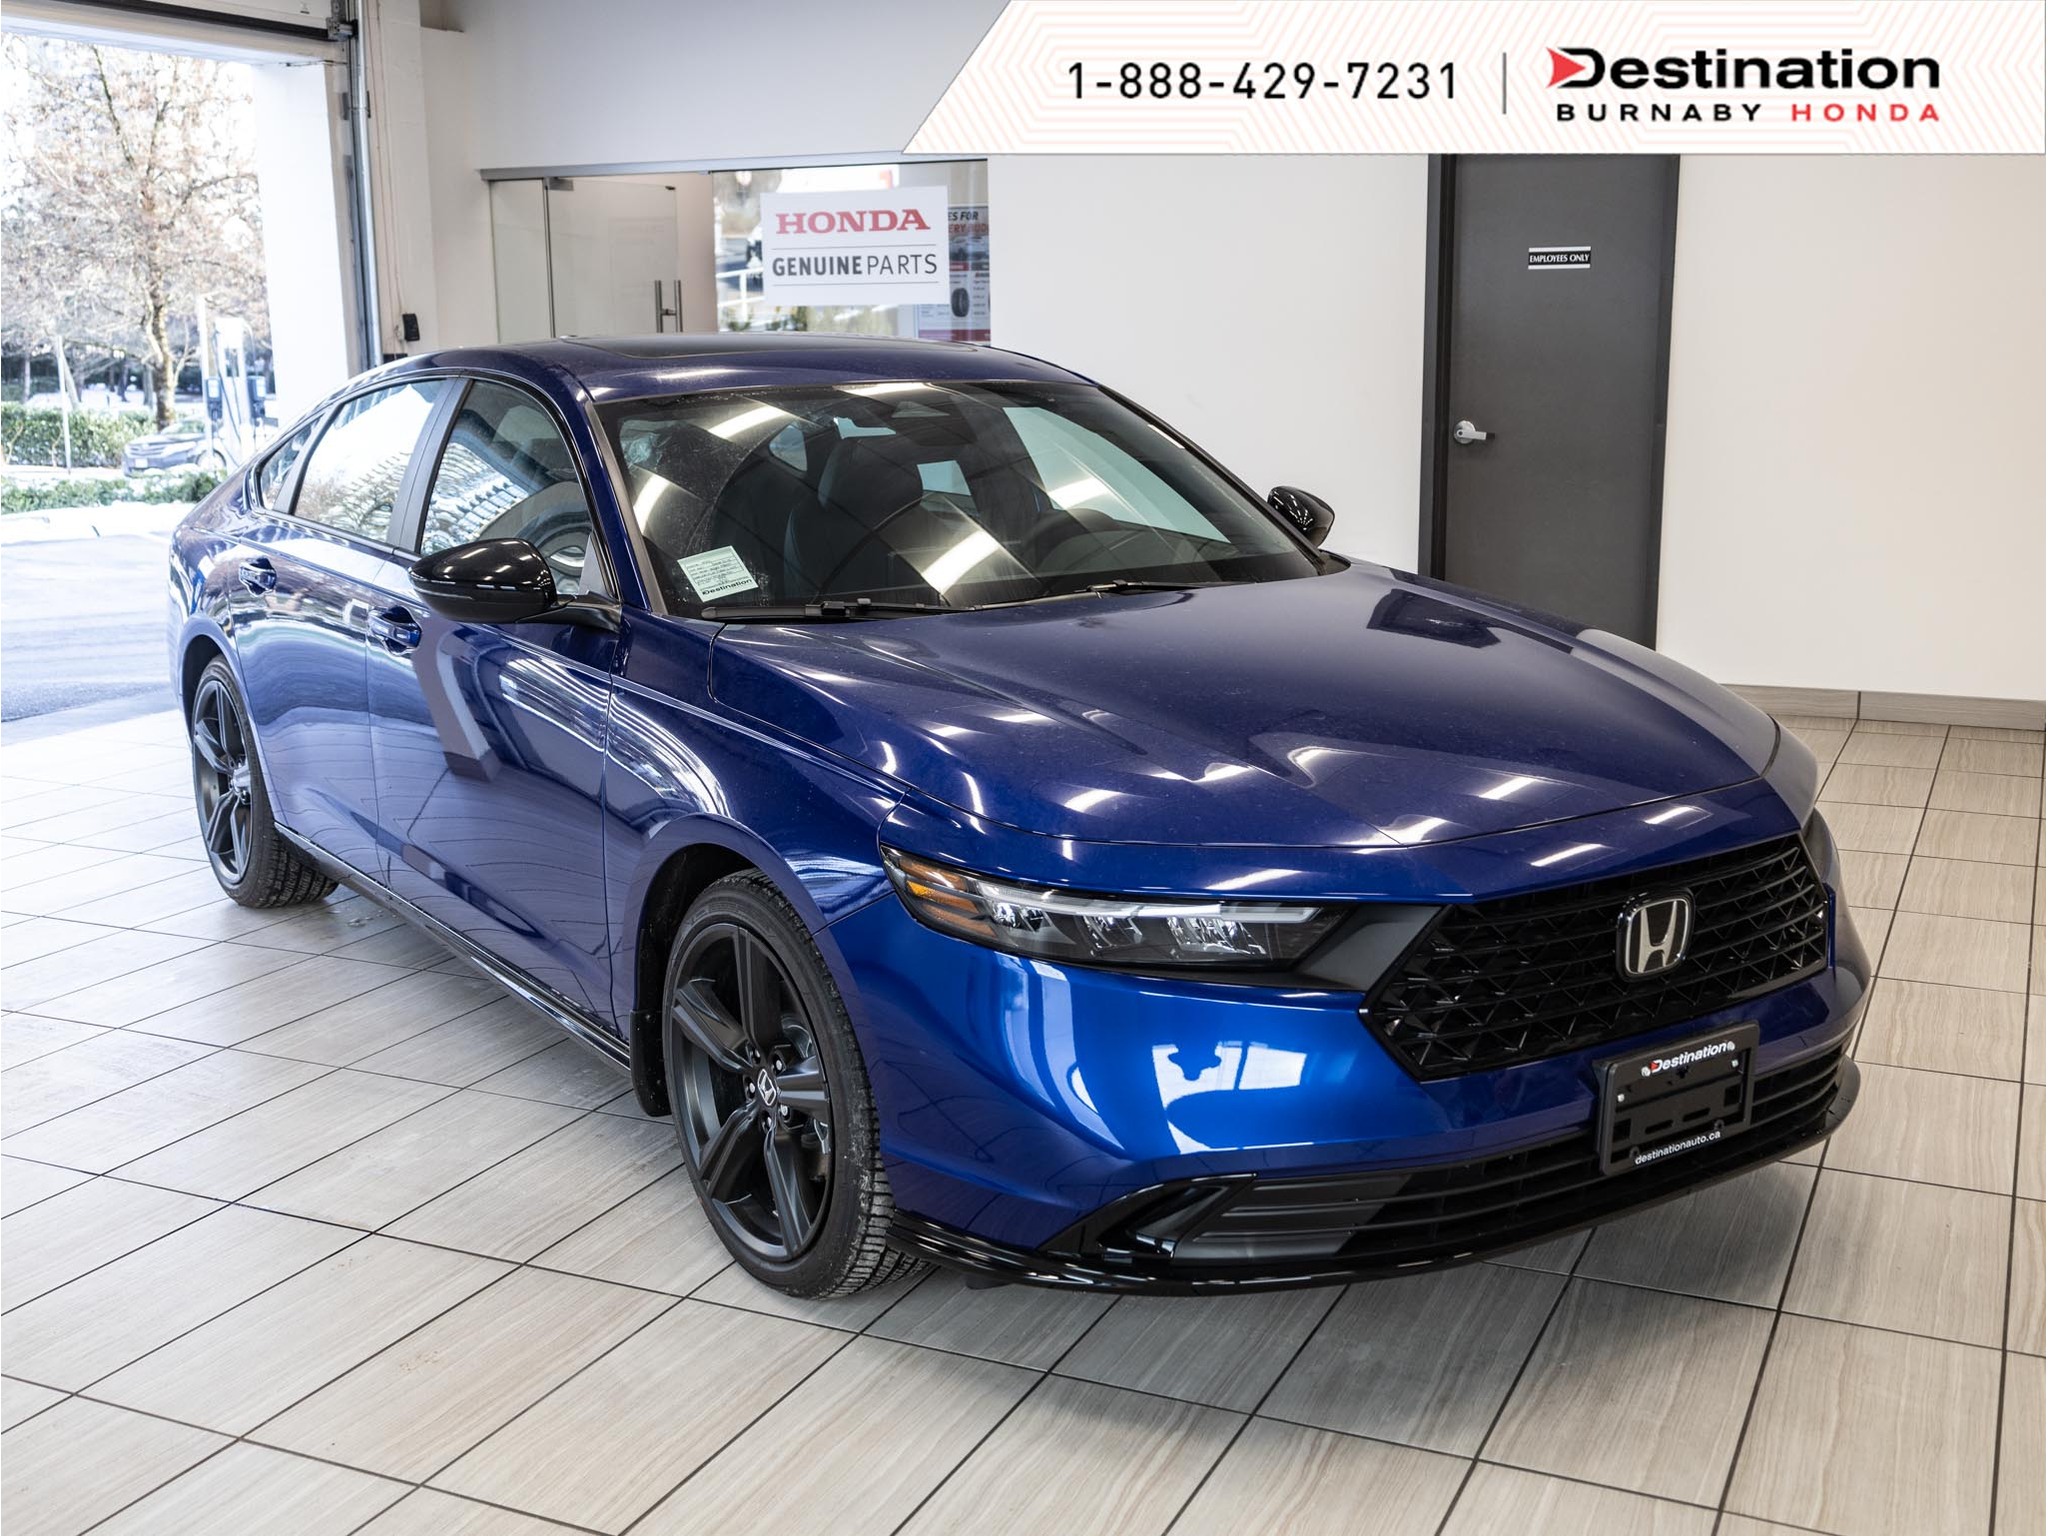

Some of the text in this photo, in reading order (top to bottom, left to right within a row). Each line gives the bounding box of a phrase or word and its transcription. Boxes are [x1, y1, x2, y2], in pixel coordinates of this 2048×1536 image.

[776, 209, 931, 234] HONDA
[960, 211, 979, 221] FOR
[1529, 253, 1590, 263] EMPLOYEES ONLY
[702, 578, 753, 595] Destination
[1650, 1042, 1728, 1073] Destination
[1635, 1130, 1722, 1165] destinationauto.ca
